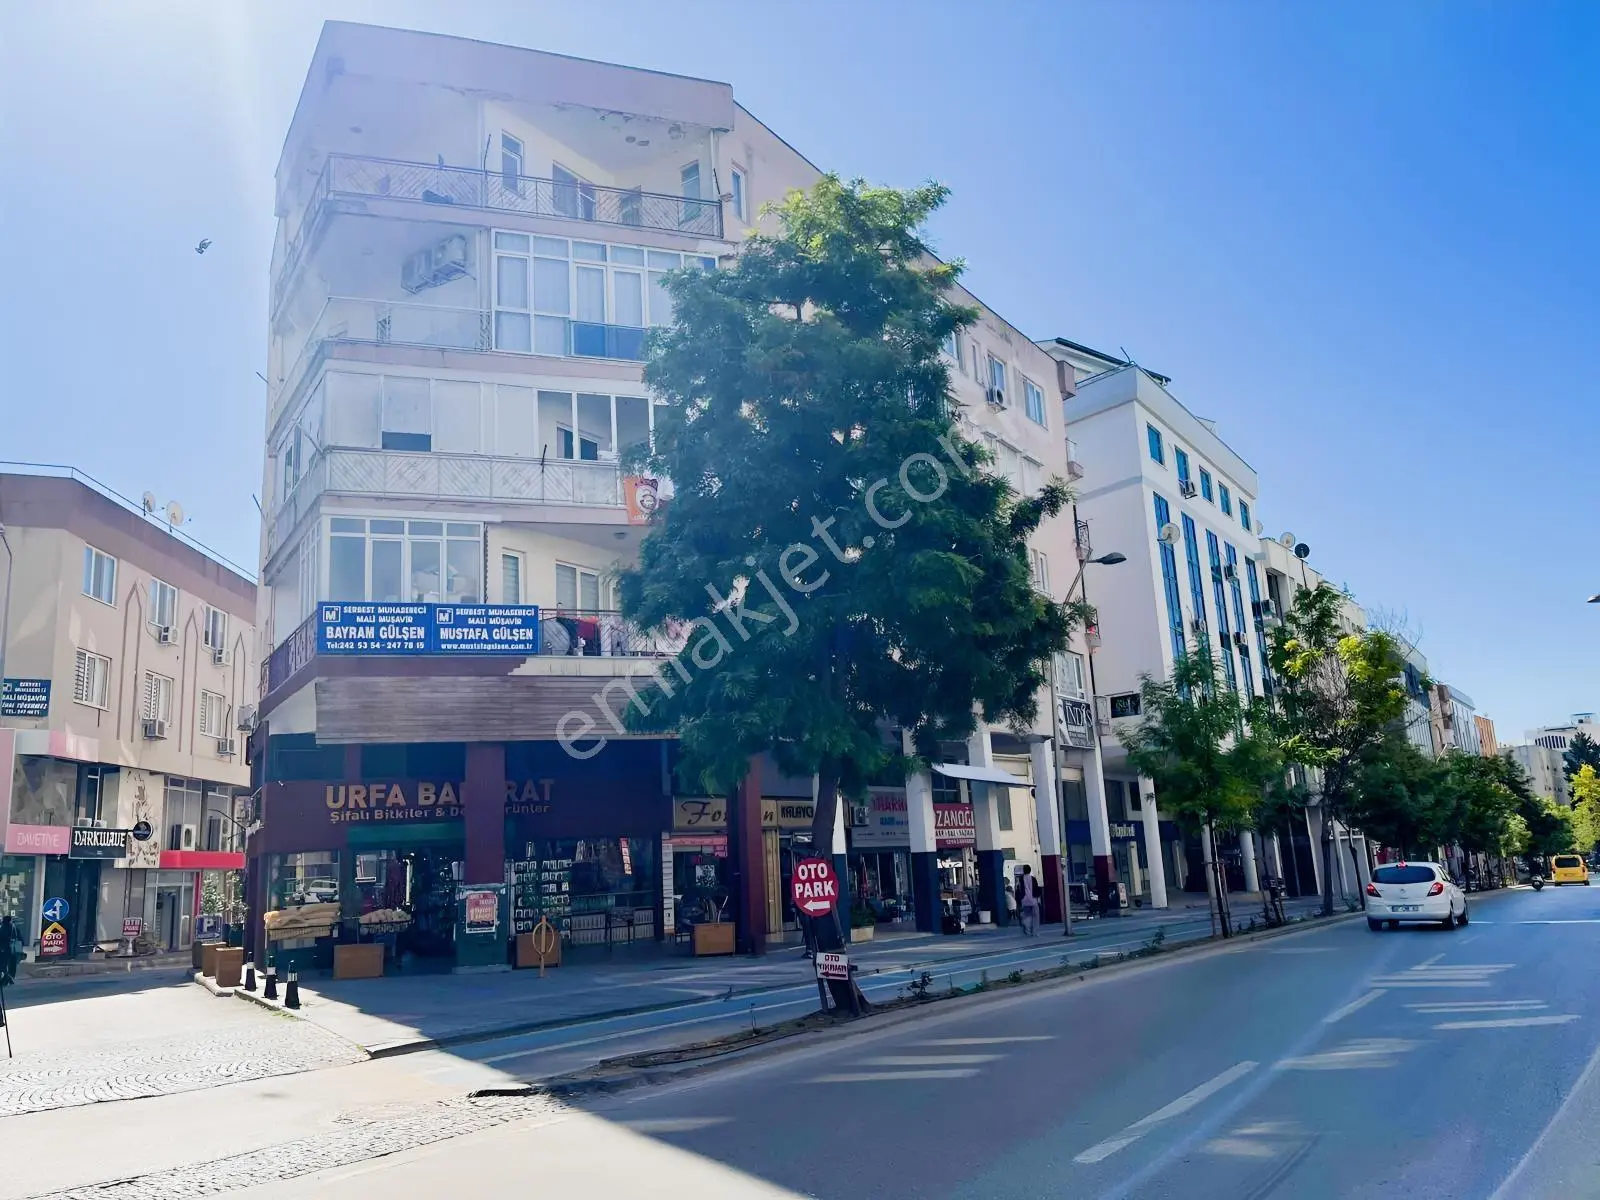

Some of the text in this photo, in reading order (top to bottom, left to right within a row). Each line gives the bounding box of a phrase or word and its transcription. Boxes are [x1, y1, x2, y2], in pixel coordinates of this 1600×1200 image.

[356, 615, 375, 623] MALİ
[489, 617, 522, 625] MÜŞAVİR
[326, 624, 425, 640] BAYRAM GÜLŞEN
[440, 626, 533, 641] MUSTAFA GÜLŞEN
[386, 641, 401, 649] 247
[326, 779, 554, 809] URFA BARAT
[330, 809, 369, 824] Şifalı
[374, 807, 428, 820] Bitkiler
[435, 808, 446, 817] &
[505, 803, 550, 815] rünler
[74, 830, 126, 847] DARKWAVE
[798, 863, 828, 880] OTO
[795, 881, 835, 898] PARK
